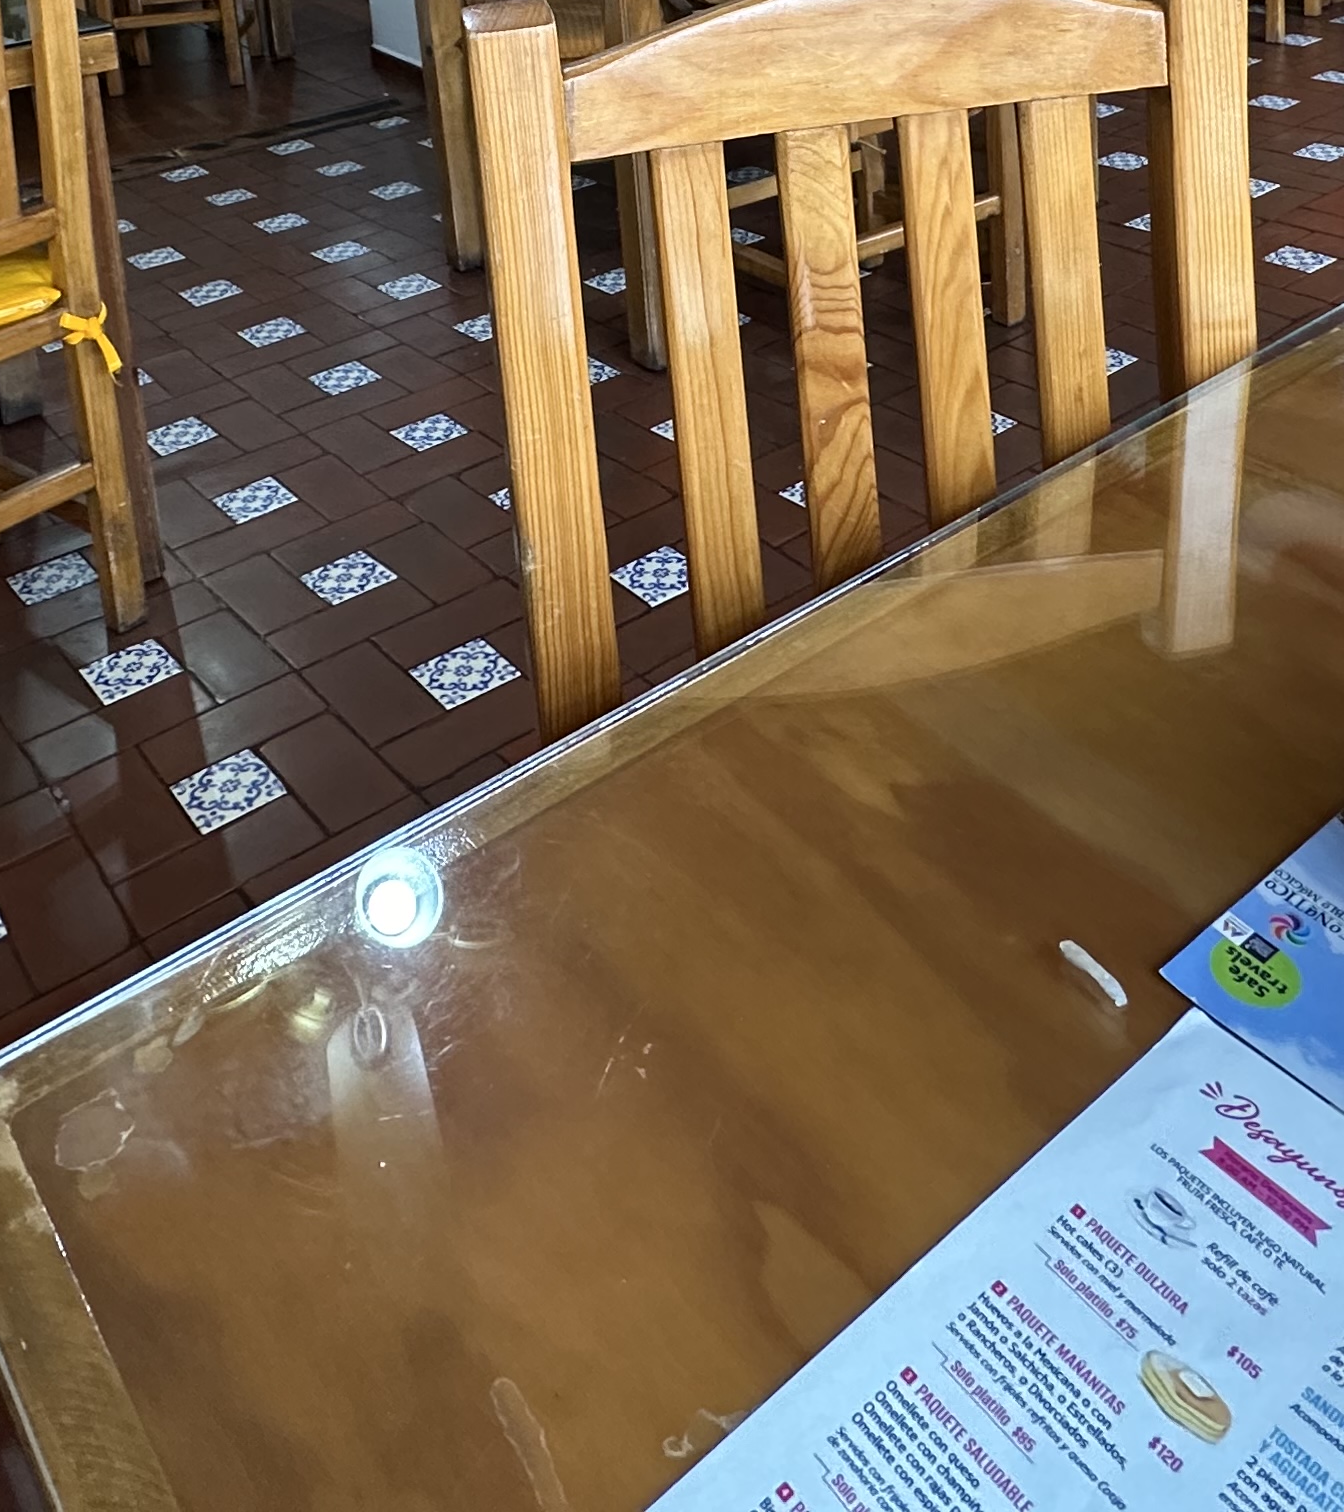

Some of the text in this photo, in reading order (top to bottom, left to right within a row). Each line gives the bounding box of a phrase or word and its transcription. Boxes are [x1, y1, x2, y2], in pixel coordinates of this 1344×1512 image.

[1225, 946, 1288, 995] travels
[1228, 961, 1270, 998] Safe
[1150, 1143, 1169, 1160] LOS
[1167, 1157, 1213, 1197] PAQUETES
[1208, 1192, 1257, 1232] INCLUYEN
[1255, 1229, 1283, 1254] JUGO
[1176, 1175, 1205, 1202] FRUTA
[1056, 1214, 1124, 1279] Hot cakes (3)
[1205, 1242, 1279, 1307] Refill de café
[1047, 1225, 1083, 1260] Servidos
[1081, 1259, 1100, 1276] con
[1097, 1274, 1121, 1293] miel
[1123, 1298, 1177, 1347] mermelada
[1050, 1259, 1139, 1340] Solo platillo $75
[1084, 1217, 1263, 1380] PAQUETE DULZURA $105
[1200, 1256, 1268, 1317] solo 2 tazas
[966, 1301, 1000, 1337] Jamón
[977, 1291, 1015, 1331] Huevos
[1021, 1335, 1034, 1351] la
[1032, 1347, 1082, 1399] Mexicana
[1090, 1407, 1112, 1431] con
[1006, 1295, 1184, 1473] PAQUETE MAÑANITAS $120
[1328, 1355, 1344, 1368] de
[1330, 1370, 1343, 1382] la
[874, 1390, 919, 1443] Omellete
[916, 1441, 938, 1466] con
[885, 1379, 930, 1432] Omellete
[928, 1430, 949, 1454] con
[947, 1452, 980, 1490] queso
[945, 1321, 982, 1360] Servidos
[980, 1358, 999, 1377] con
[992, 1375, 1028, 1409] frijoles
[1026, 1407, 1063, 1445] refritos
[1067, 1451, 1099, 1482] queso
[1097, 1480, 1127, 1511] Cotija
[950, 1359, 1037, 1453] Solo platillo $85
[1027, 1382, 1089, 1449] Divorciados
[826, 1435, 840, 1448] de
[837, 1448, 882, 1497] zanahoria
[835, 1426, 871, 1468] Servidos
[868, 1466, 886, 1486] con
[851, 1411, 896, 1466] Omellete
[894, 1464, 915, 1488] con
[913, 1487, 941, 1512] espi
[863, 1401, 953, 1507] Omellete con rajas
[914, 1383, 1034, 1512] PAQUETE SALUDABLE
[1269, 1425, 1330, 1487] TOSTADA
[831, 1473, 858, 1505] Solo
[1236, 1469, 1260, 1493] con
[1245, 1455, 1297, 1506] 2 piezas
